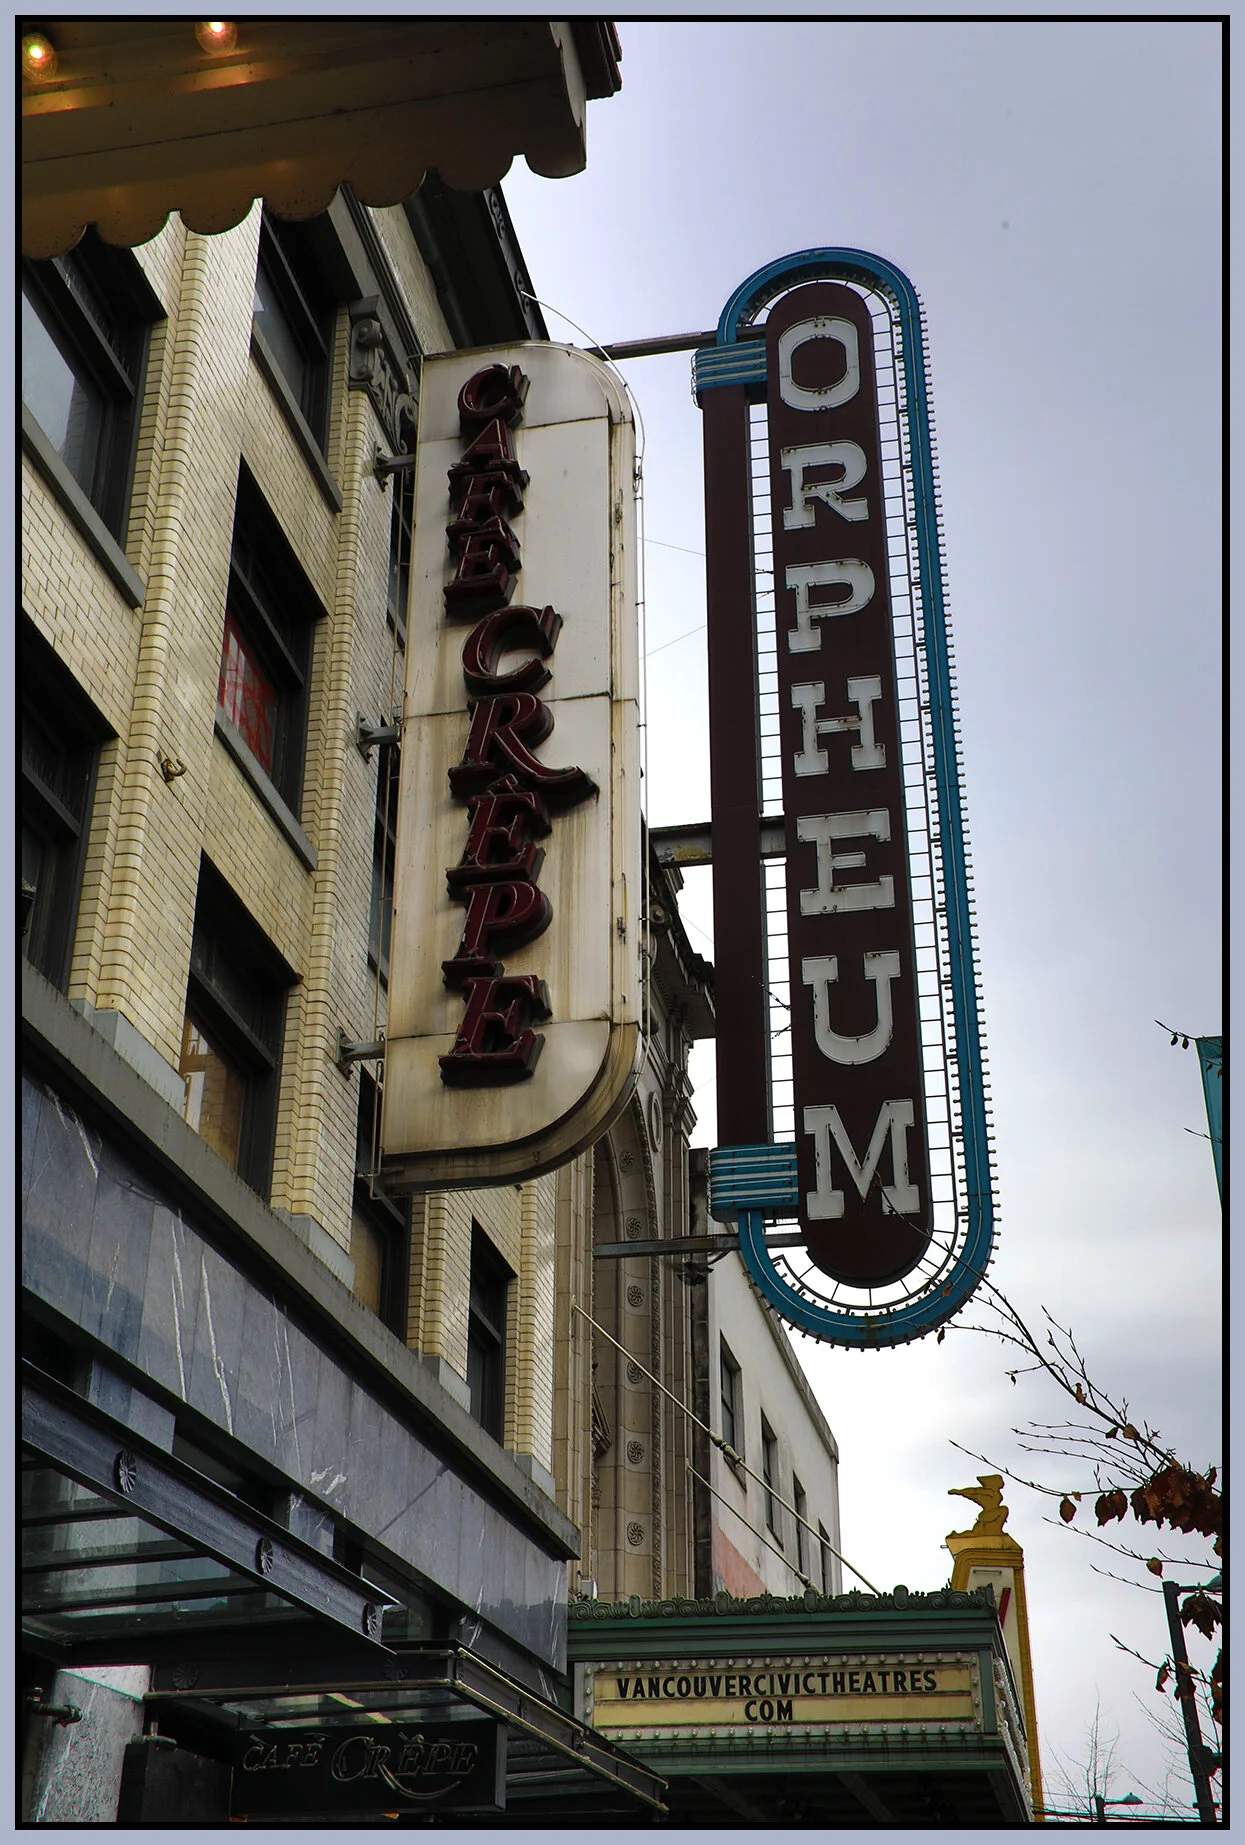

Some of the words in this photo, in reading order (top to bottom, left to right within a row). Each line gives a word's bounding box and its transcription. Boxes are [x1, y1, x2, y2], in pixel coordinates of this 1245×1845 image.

[438, 603, 600, 1087] CRÊPE
[776, 315, 921, 1221] ORPHEUM
[616, 1669, 938, 1699] VANCOUVERCIVICTHEATRES
[743, 1699, 794, 1722] COM
